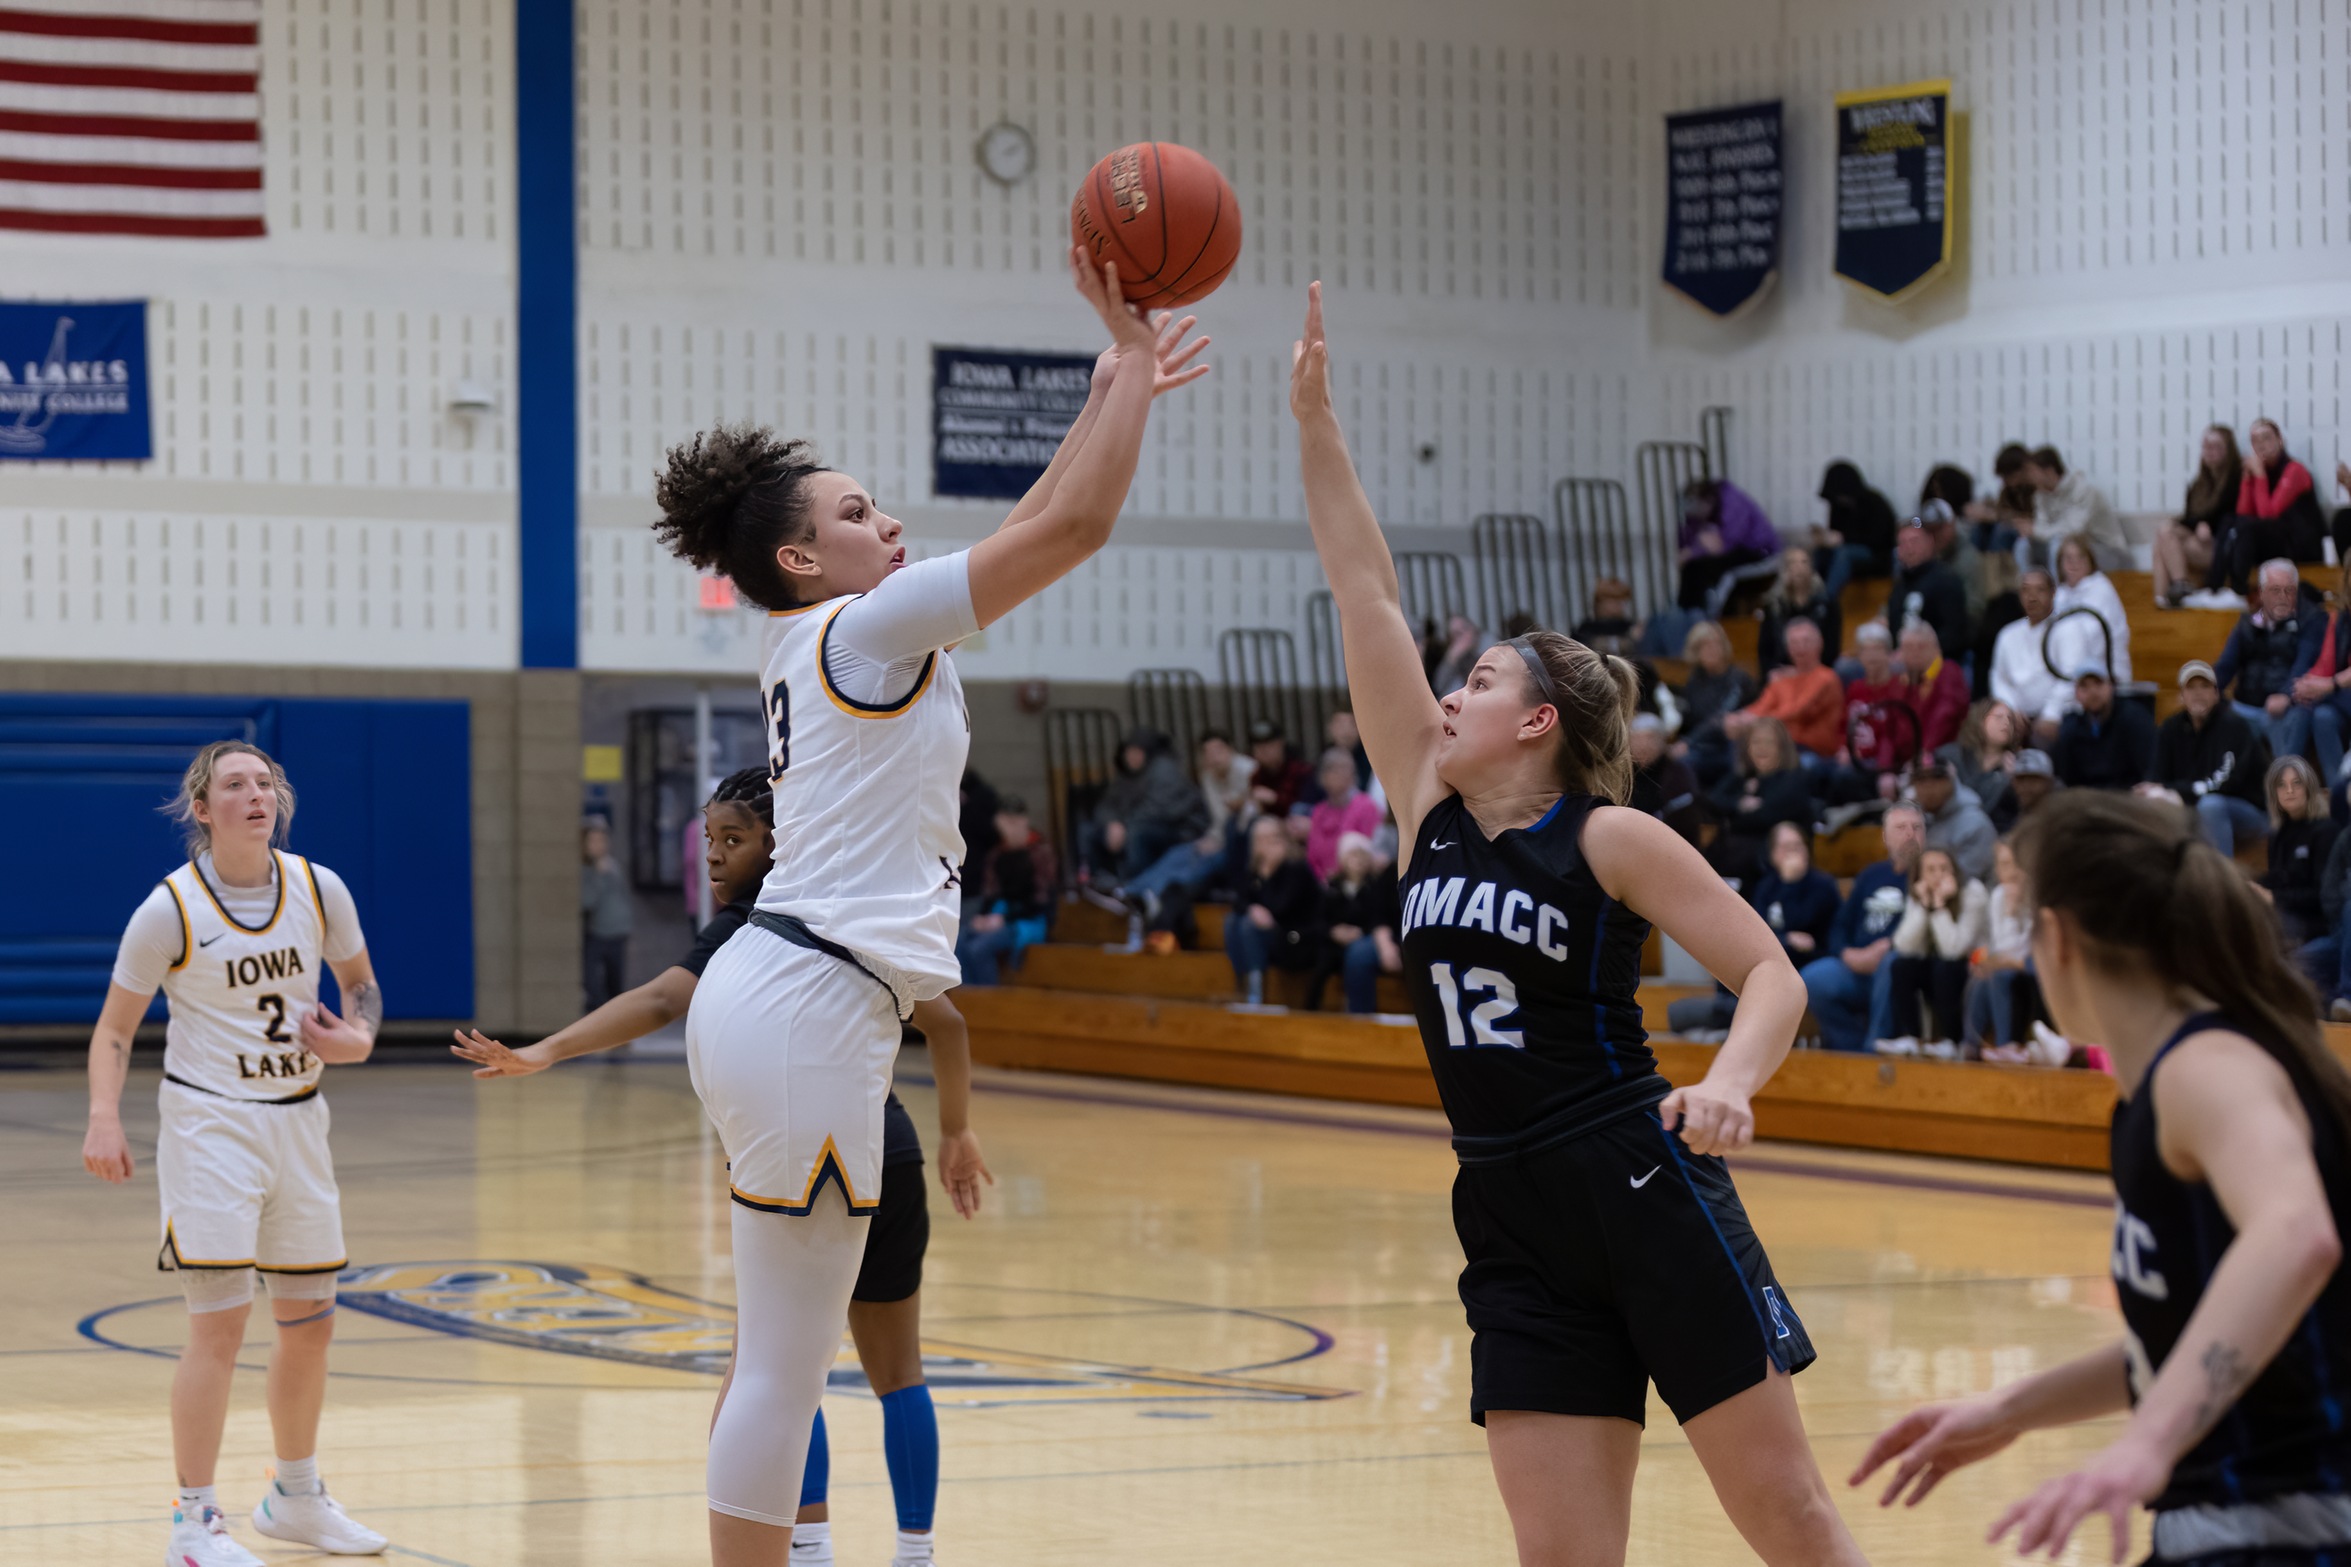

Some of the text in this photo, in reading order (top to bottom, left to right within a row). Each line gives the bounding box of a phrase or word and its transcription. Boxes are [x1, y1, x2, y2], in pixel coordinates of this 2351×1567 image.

[24, 359, 129, 384] LAKES
[950, 361, 1091, 392] IOWA LAKES
[45, 392, 129, 414] COLLEGE
[225, 946, 304, 988] IOWA
[258, 993, 292, 1043] 2
[1430, 961, 1526, 1049] 12
